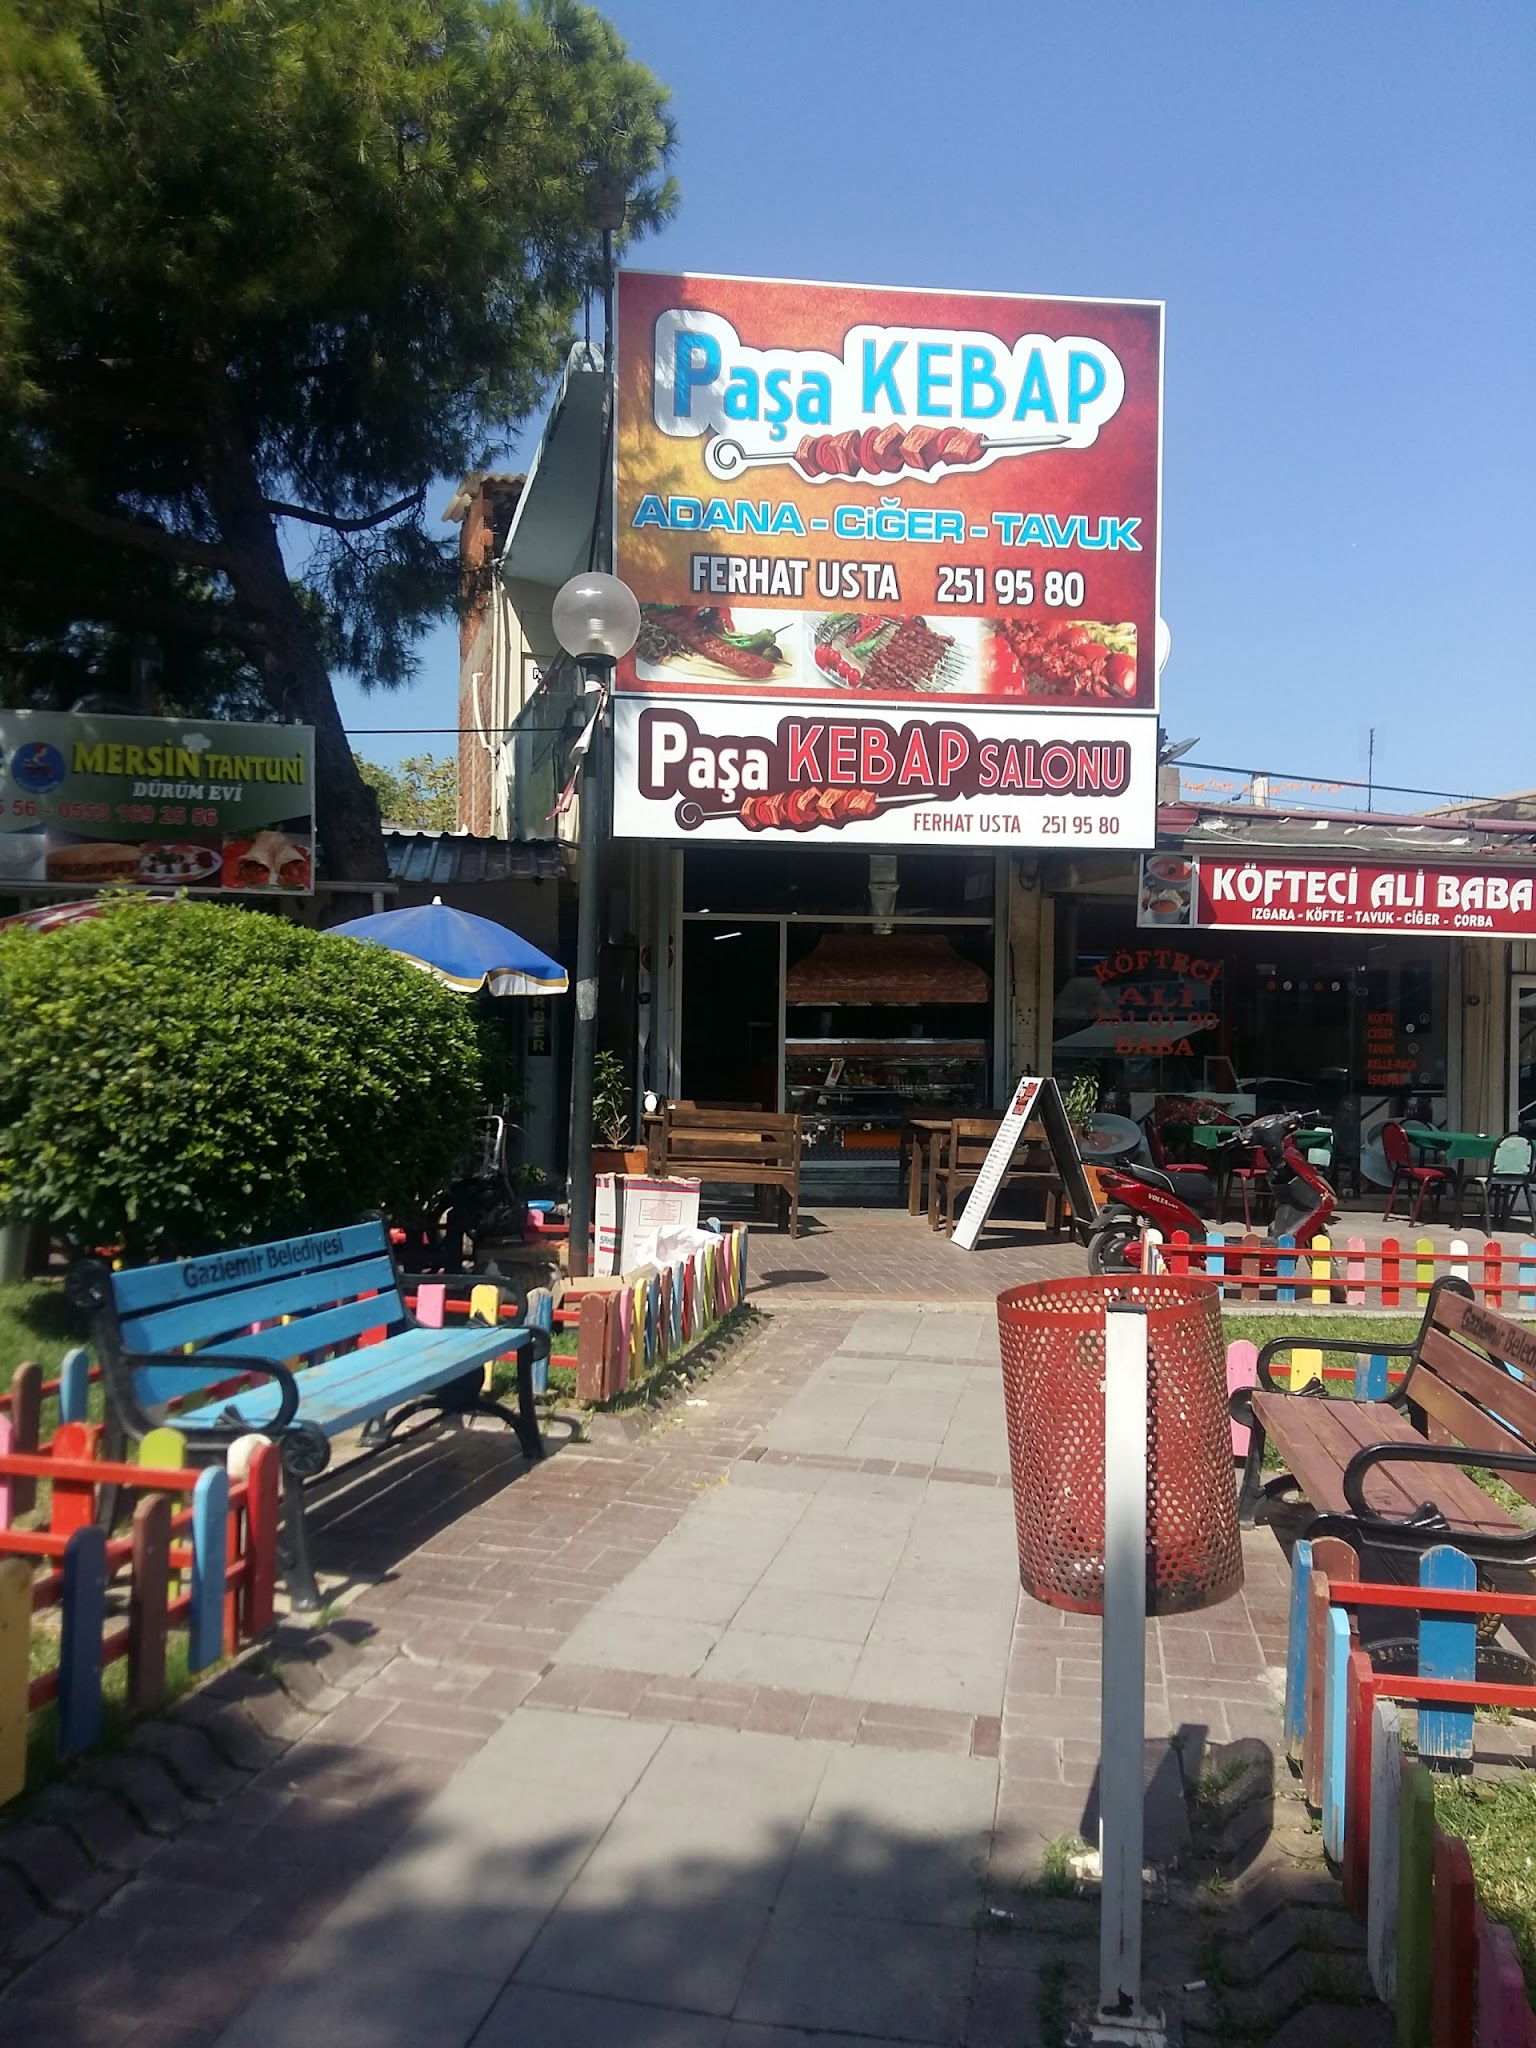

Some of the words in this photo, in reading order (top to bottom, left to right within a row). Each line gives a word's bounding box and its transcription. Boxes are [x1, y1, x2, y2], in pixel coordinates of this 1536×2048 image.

[674, 330, 832, 442] Paşa
[862, 338, 1107, 424] KEBAP
[632, 495, 807, 537] ADANA
[992, 512, 1143, 551] TAVUK
[693, 555, 808, 596] FERHAT
[818, 561, 900, 600] USTA
[937, 566, 985, 604] 251
[995, 568, 1034, 606] 95
[1044, 570, 1085, 608] 80
[73, 738, 201, 777] MERSİN
[205, 751, 305, 785] TANTUNİ
[651, 720, 769, 804] Paşa
[788, 724, 970, 787] KEBAP
[979, 744, 1125, 789] SALONU
[132, 778, 203, 800] DÜRÜM
[207, 783, 244, 802] EVİ
[913, 813, 974, 833] FERHAT
[979, 814, 1022, 833] USTA
[1042, 815, 1066, 834] 251
[1072, 816, 1093, 834] 95
[1099, 816, 1120, 834] 80
[1213, 862, 1359, 906] KÖFTECİ
[1371, 868, 1425, 909] ALİ
[1437, 875, 1534, 914] BABA
[1252, 907, 1295, 921] IZGARA
[1306, 906, 1345, 923] KÖFTE
[1355, 911, 1394, 925] TAVUK
[1404, 908, 1440, 926] CİĞER
[1454, 914, 1494, 928] ÇORBA
[1114, 1036, 1195, 1057] BABA
[183, 1252, 264, 1289] Gaziemir
[267, 1232, 345, 1269] Belediyesi
